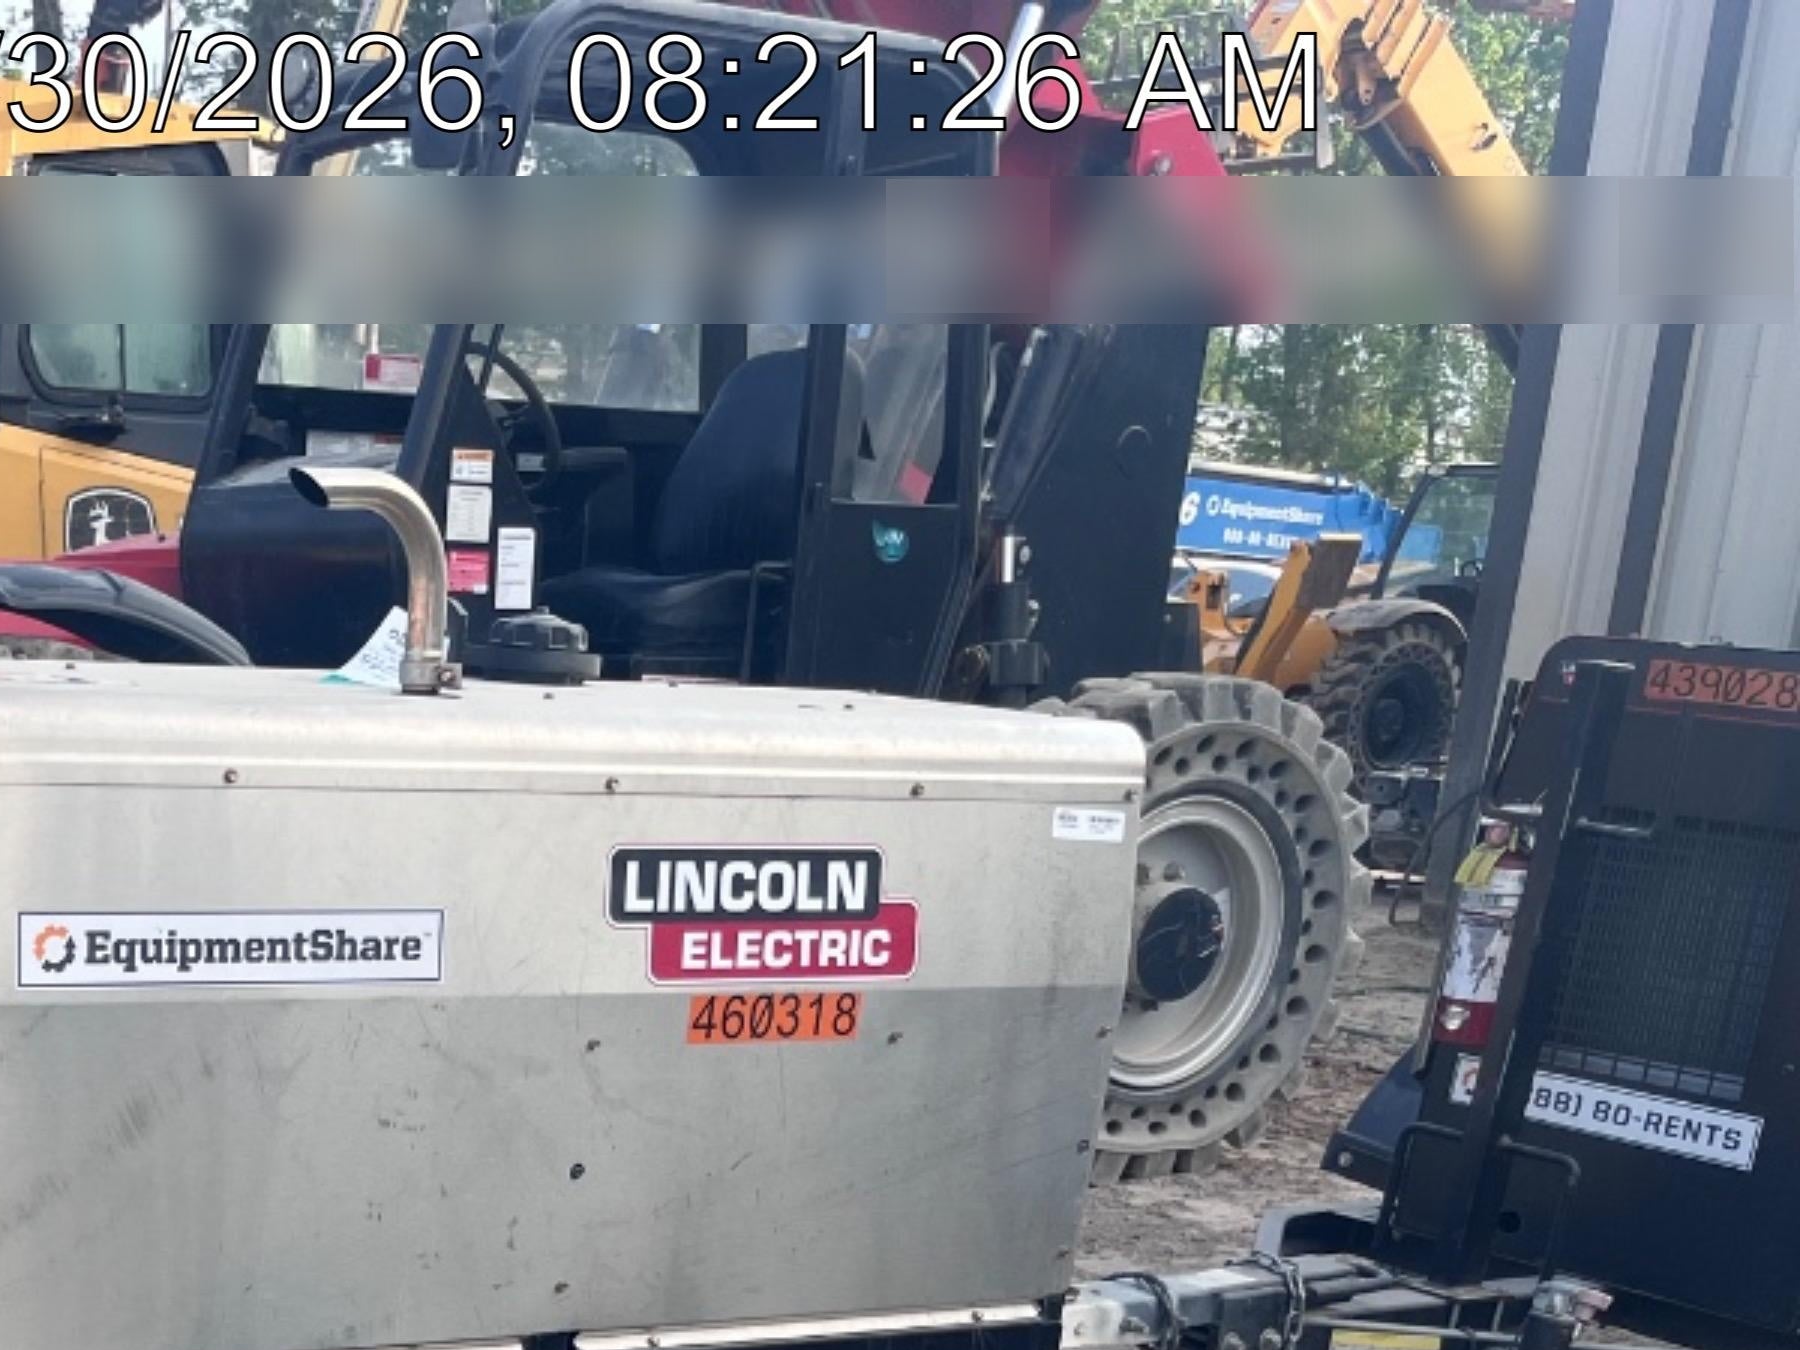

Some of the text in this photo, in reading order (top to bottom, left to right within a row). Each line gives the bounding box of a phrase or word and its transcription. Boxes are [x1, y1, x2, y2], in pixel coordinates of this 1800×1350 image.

[1650, 662, 1798, 708] 439028
[623, 860, 868, 913] LINCOLN
[83, 929, 422, 973] EquipmentShare
[680, 929, 892, 970] ELECTRIC
[691, 992, 857, 1039] 460318
[1592, 1099, 1741, 1151] 80-RENTS
